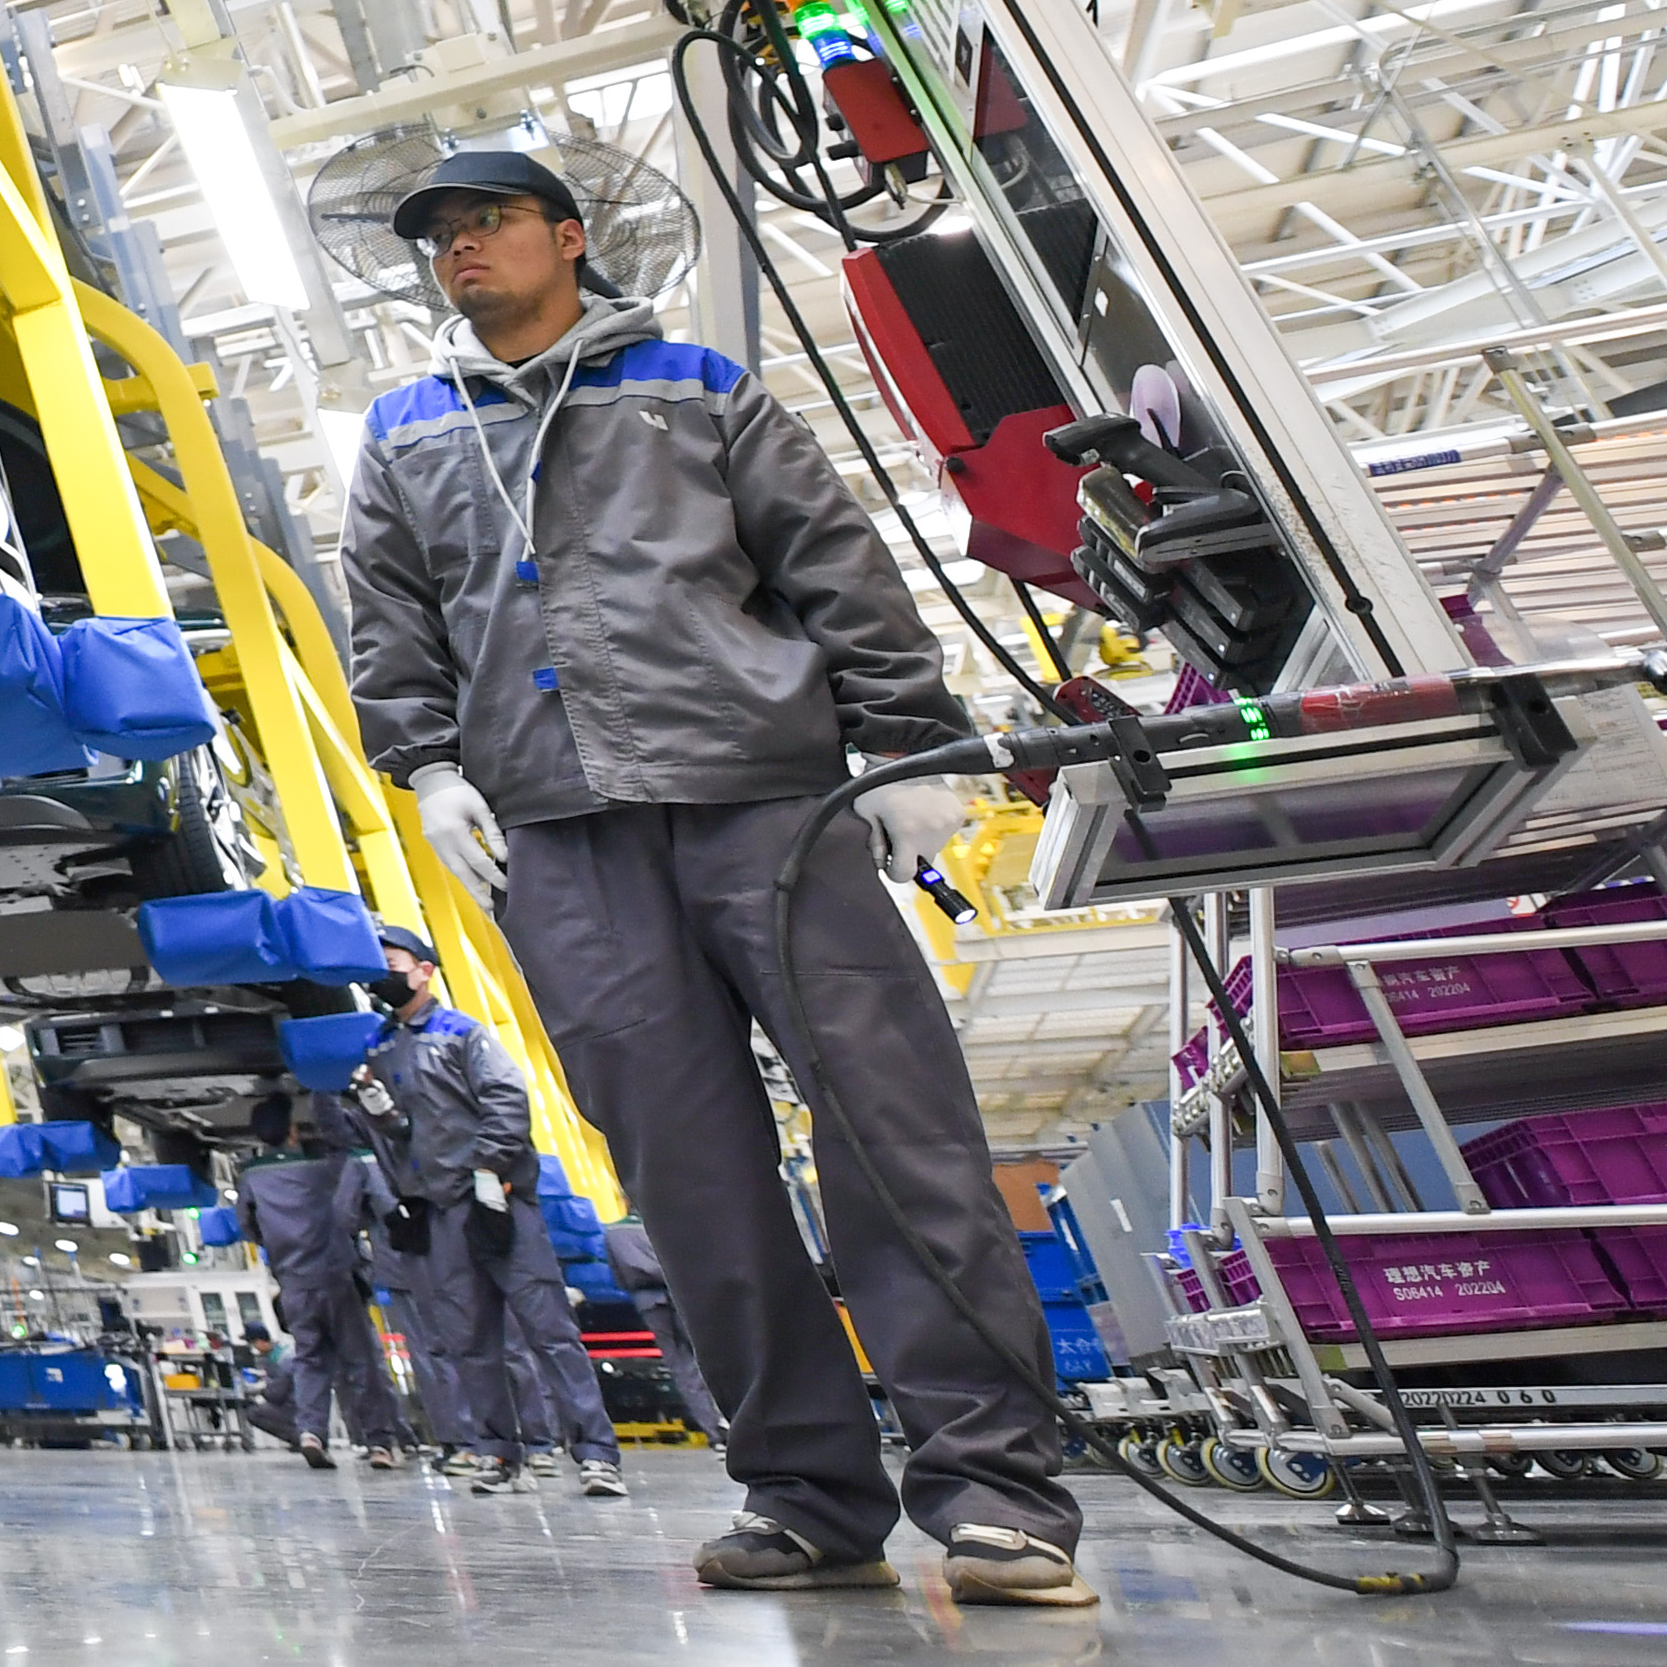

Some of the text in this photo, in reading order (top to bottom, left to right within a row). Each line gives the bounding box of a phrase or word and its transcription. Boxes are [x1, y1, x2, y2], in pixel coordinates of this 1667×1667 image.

[1383, 1259, 1491, 1284] 理想汽车资产
[1392, 1280, 1507, 1302] S06414 202204
